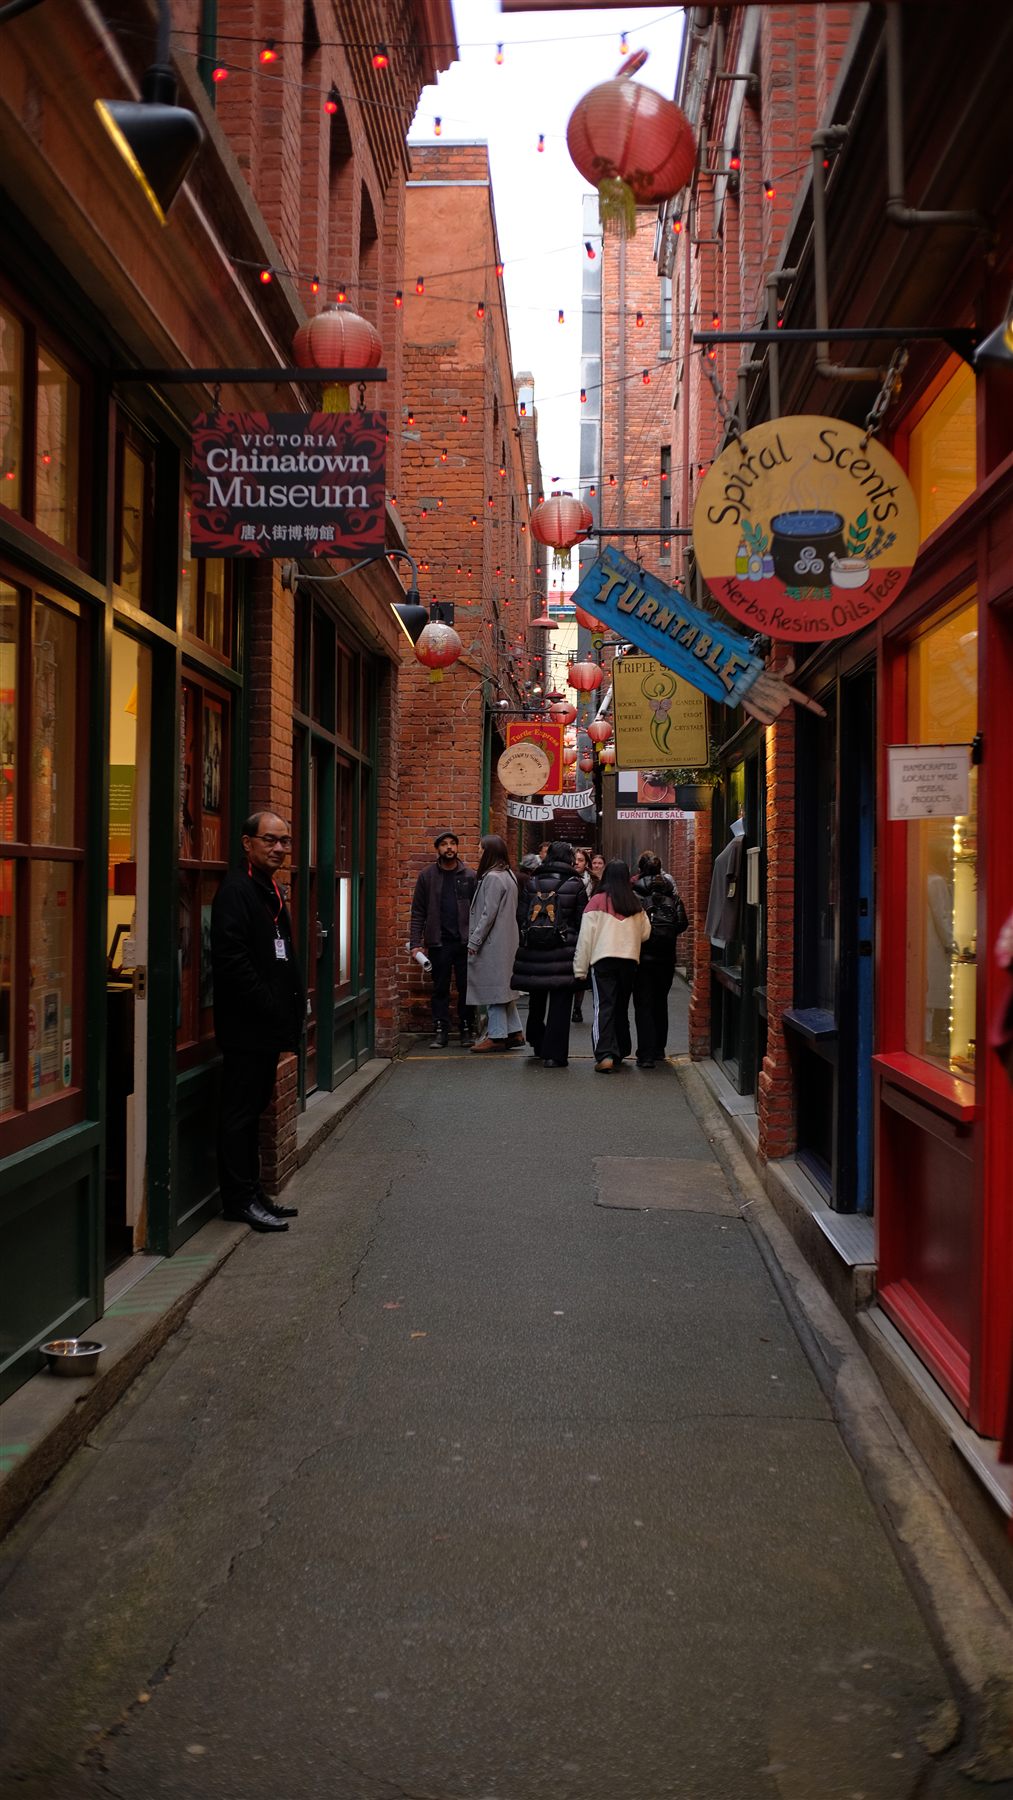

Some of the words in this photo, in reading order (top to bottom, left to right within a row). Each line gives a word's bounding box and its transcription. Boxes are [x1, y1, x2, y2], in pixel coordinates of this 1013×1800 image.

[241, 434, 338, 448] VICTORIA
[206, 448, 370, 473] Chinatown
[707, 432, 793, 526] Spiral
[813, 429, 899, 523] Scents
[206, 476, 370, 508] Museum
[241, 524, 335, 541] 唐人街博物館
[864, 567, 902, 603] Teas
[594, 565, 749, 695] TURNTABLE
[616, 662, 655, 674] TRIPLE
[511, 730, 532, 743] Turtle
[903, 763, 957, 771] HANDCRAFTED
[552, 792, 590, 808] CONTENT
[912, 795, 951, 803] PRODUCTS
[507, 802, 550, 820] HEARTS
[620, 811, 663, 819] FURNITURE
[665, 811, 684, 819] SALE
